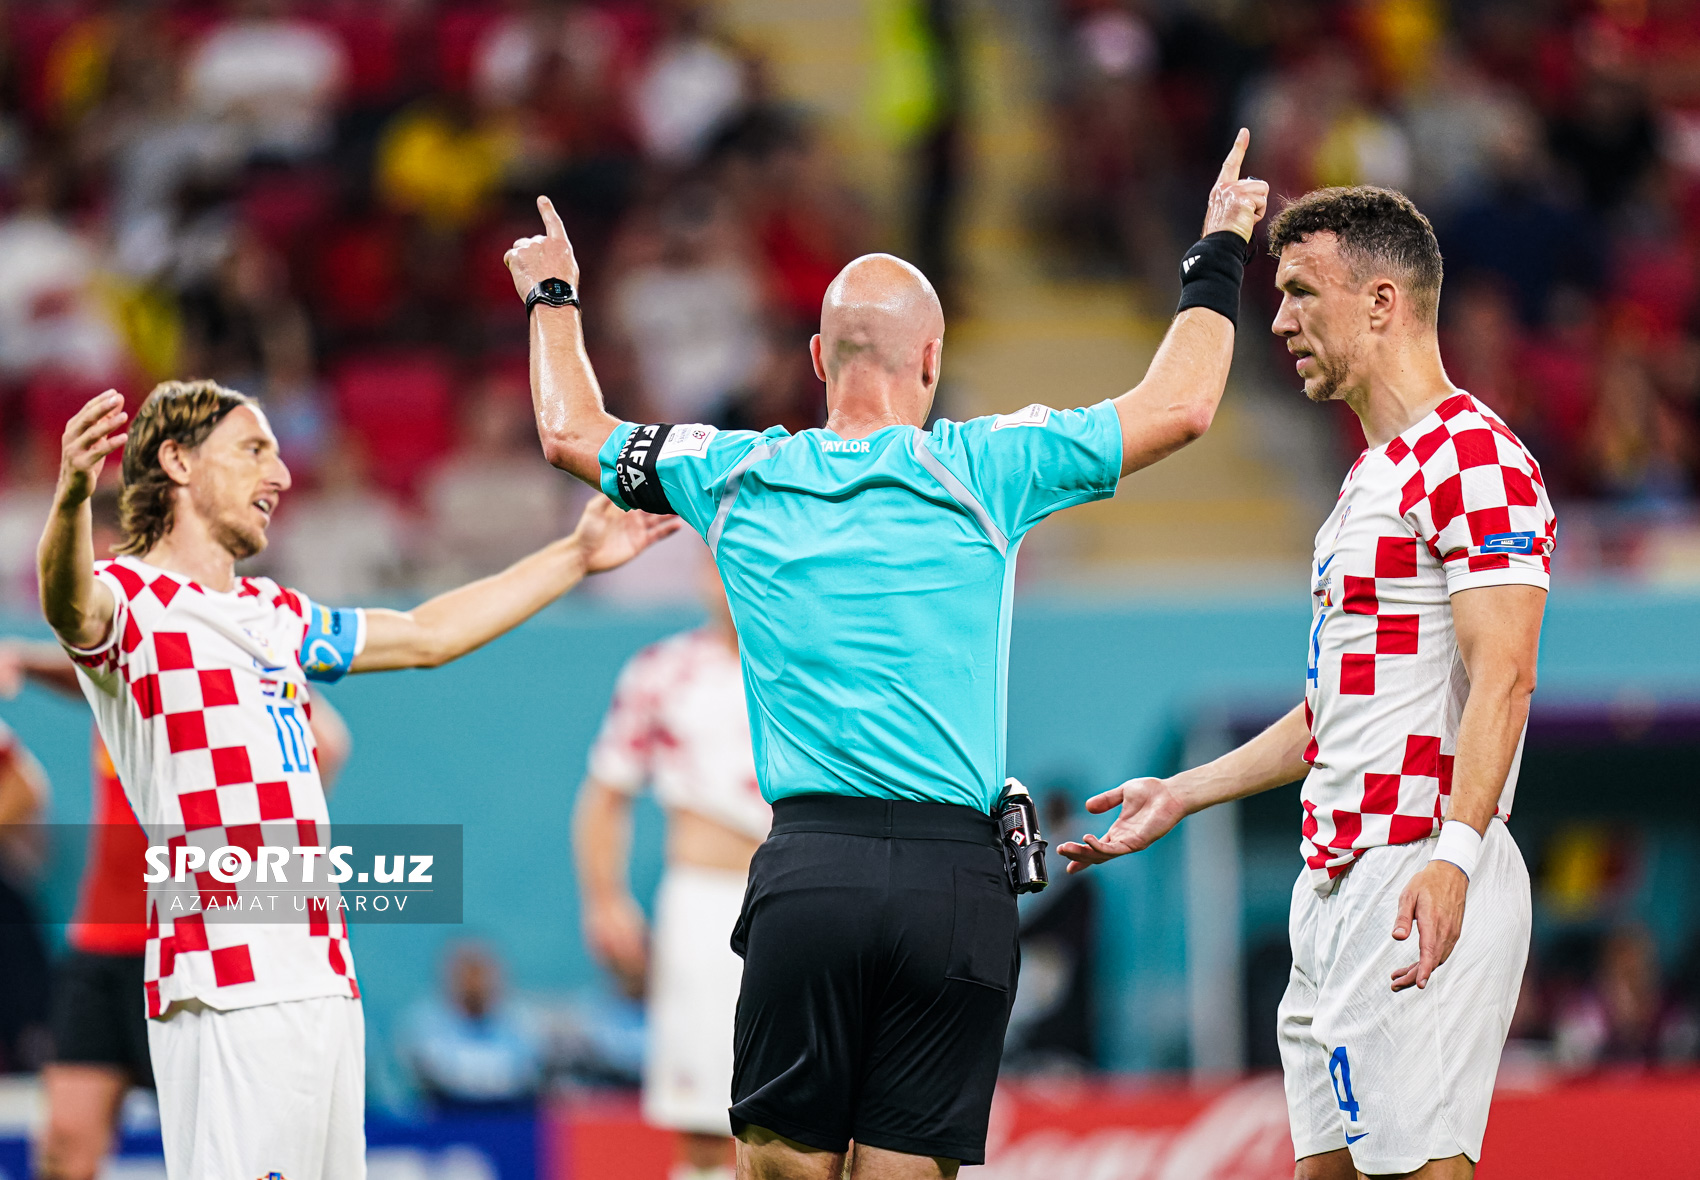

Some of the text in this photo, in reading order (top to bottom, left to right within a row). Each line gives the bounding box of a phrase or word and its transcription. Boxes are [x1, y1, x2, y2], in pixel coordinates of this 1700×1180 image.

[616, 427, 640, 492] TEAM ONE
[626, 425, 661, 490] FIFA
[820, 440, 870, 453] TAYLOR
[266, 704, 311, 773] 10
[1329, 1046, 1360, 1122] 4
